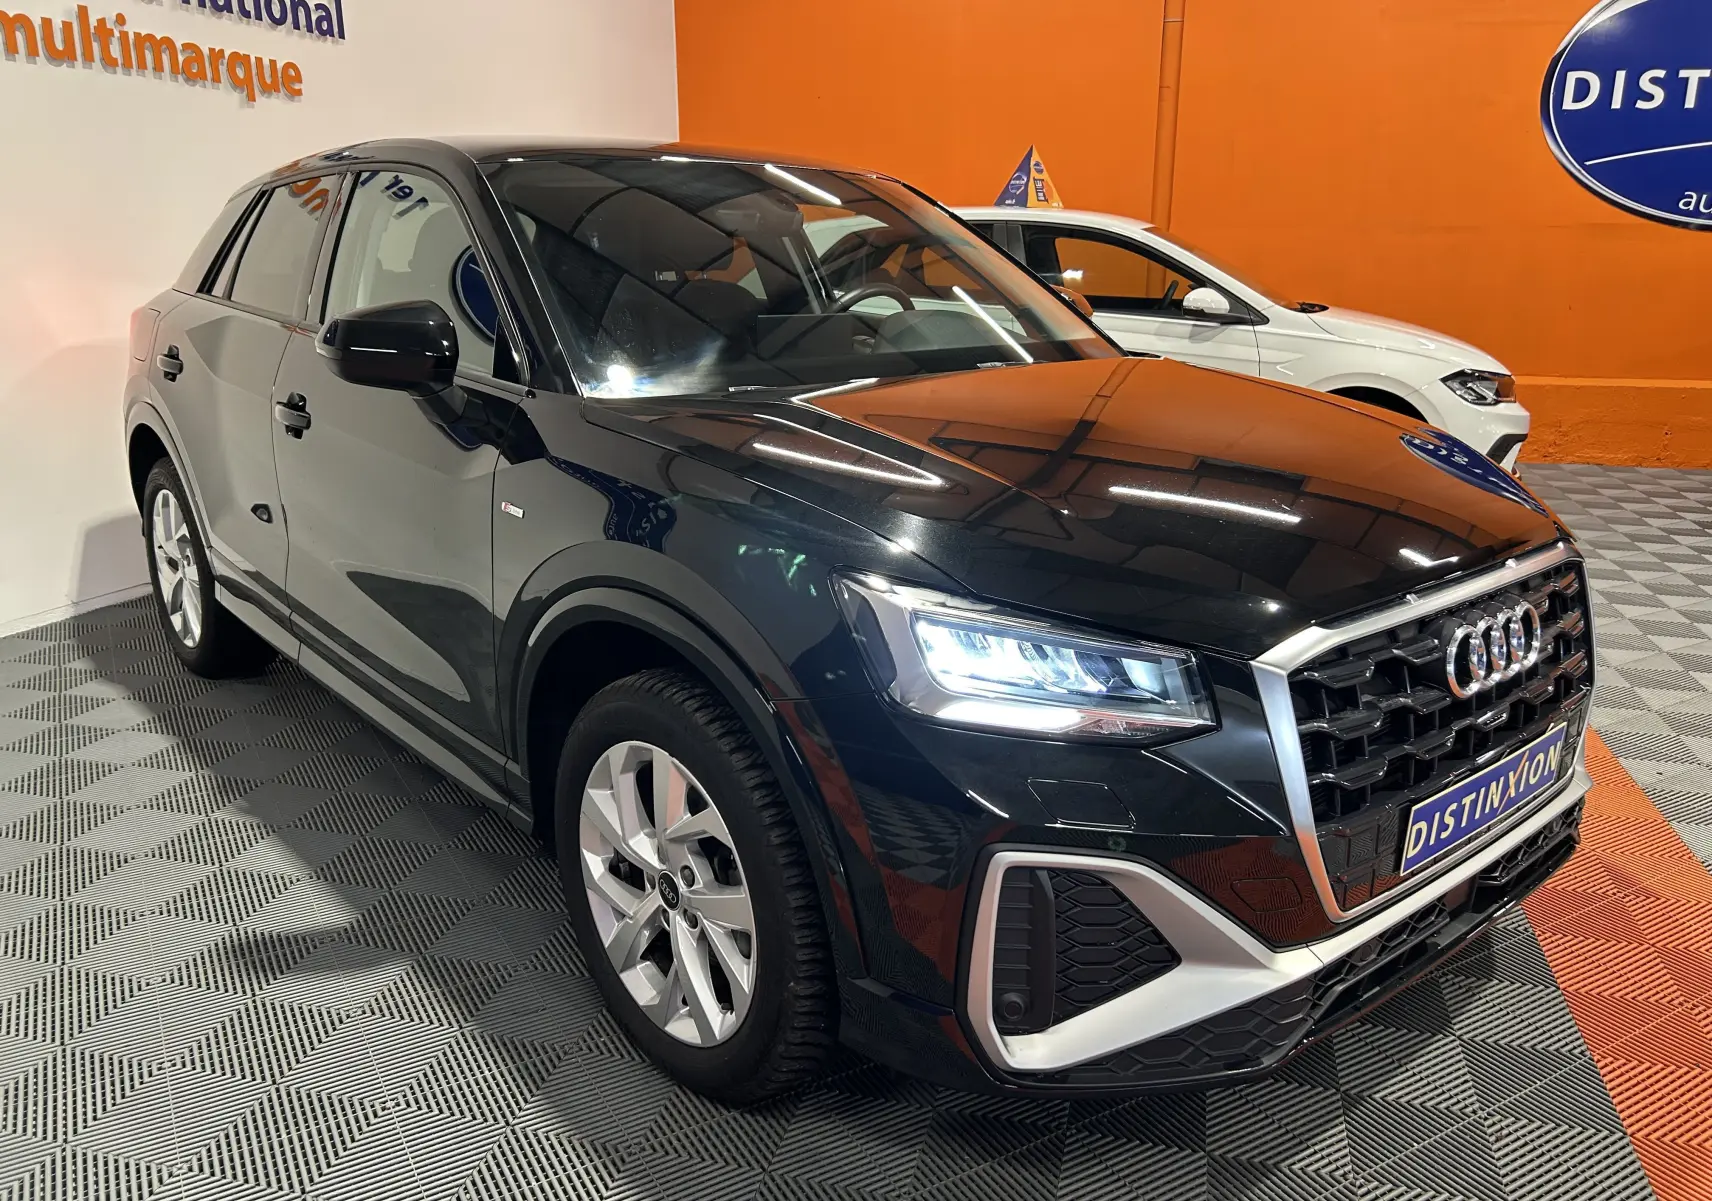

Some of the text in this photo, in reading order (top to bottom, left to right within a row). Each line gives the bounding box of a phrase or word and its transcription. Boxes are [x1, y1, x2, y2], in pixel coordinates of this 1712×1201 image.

[0, 4, 303, 102] multimarque
[181, 0, 345, 40] tional
[1562, 69, 1712, 110] DIST
[1407, 745, 1558, 859] DISTINXION
